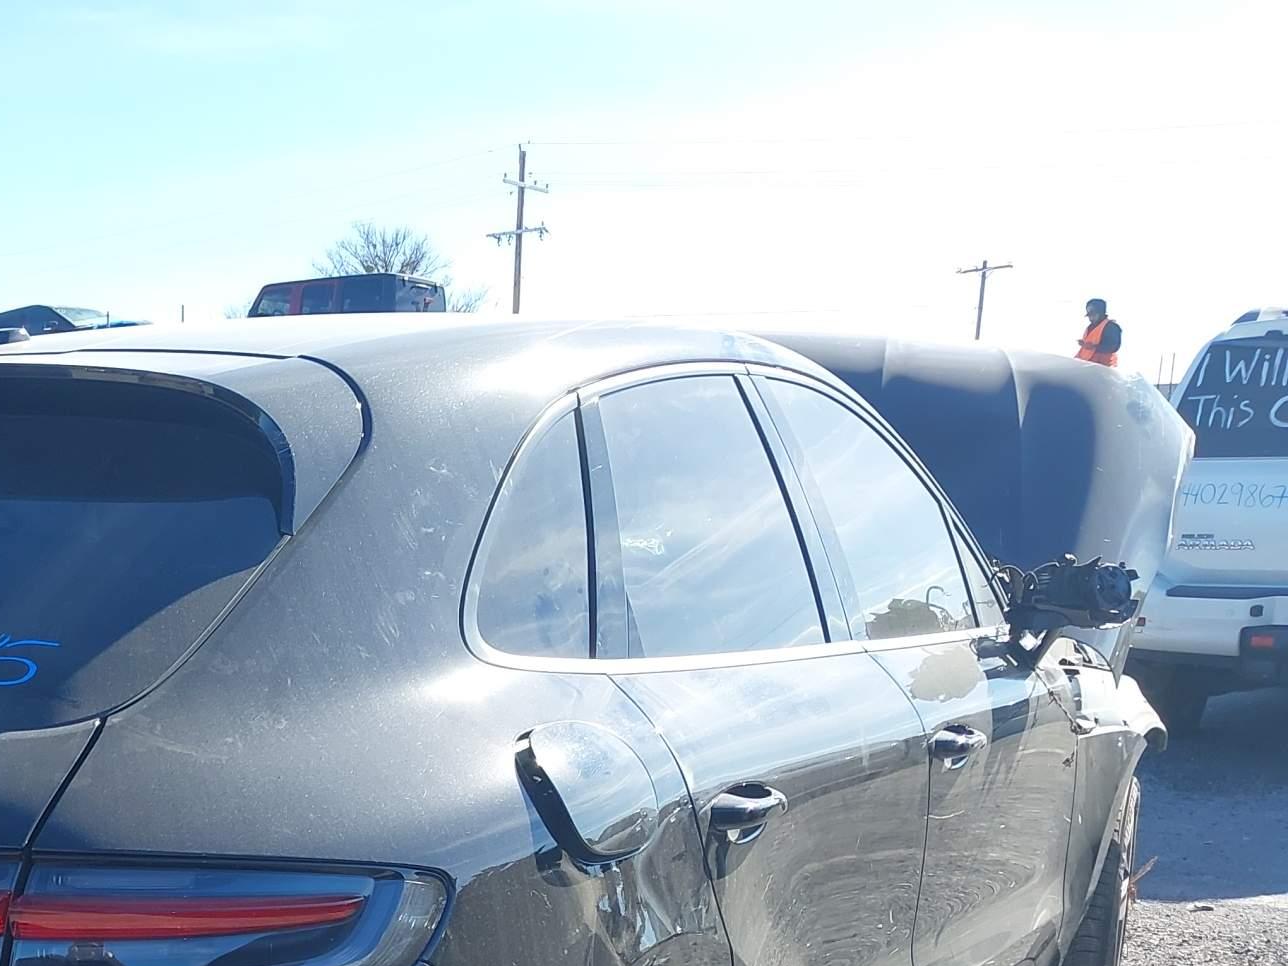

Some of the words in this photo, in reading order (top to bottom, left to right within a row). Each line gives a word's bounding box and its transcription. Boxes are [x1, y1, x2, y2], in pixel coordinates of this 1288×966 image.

[1196, 352, 1211, 388] I
[1187, 393, 1255, 430] This
[1182, 481, 1288, 509] 44029867
